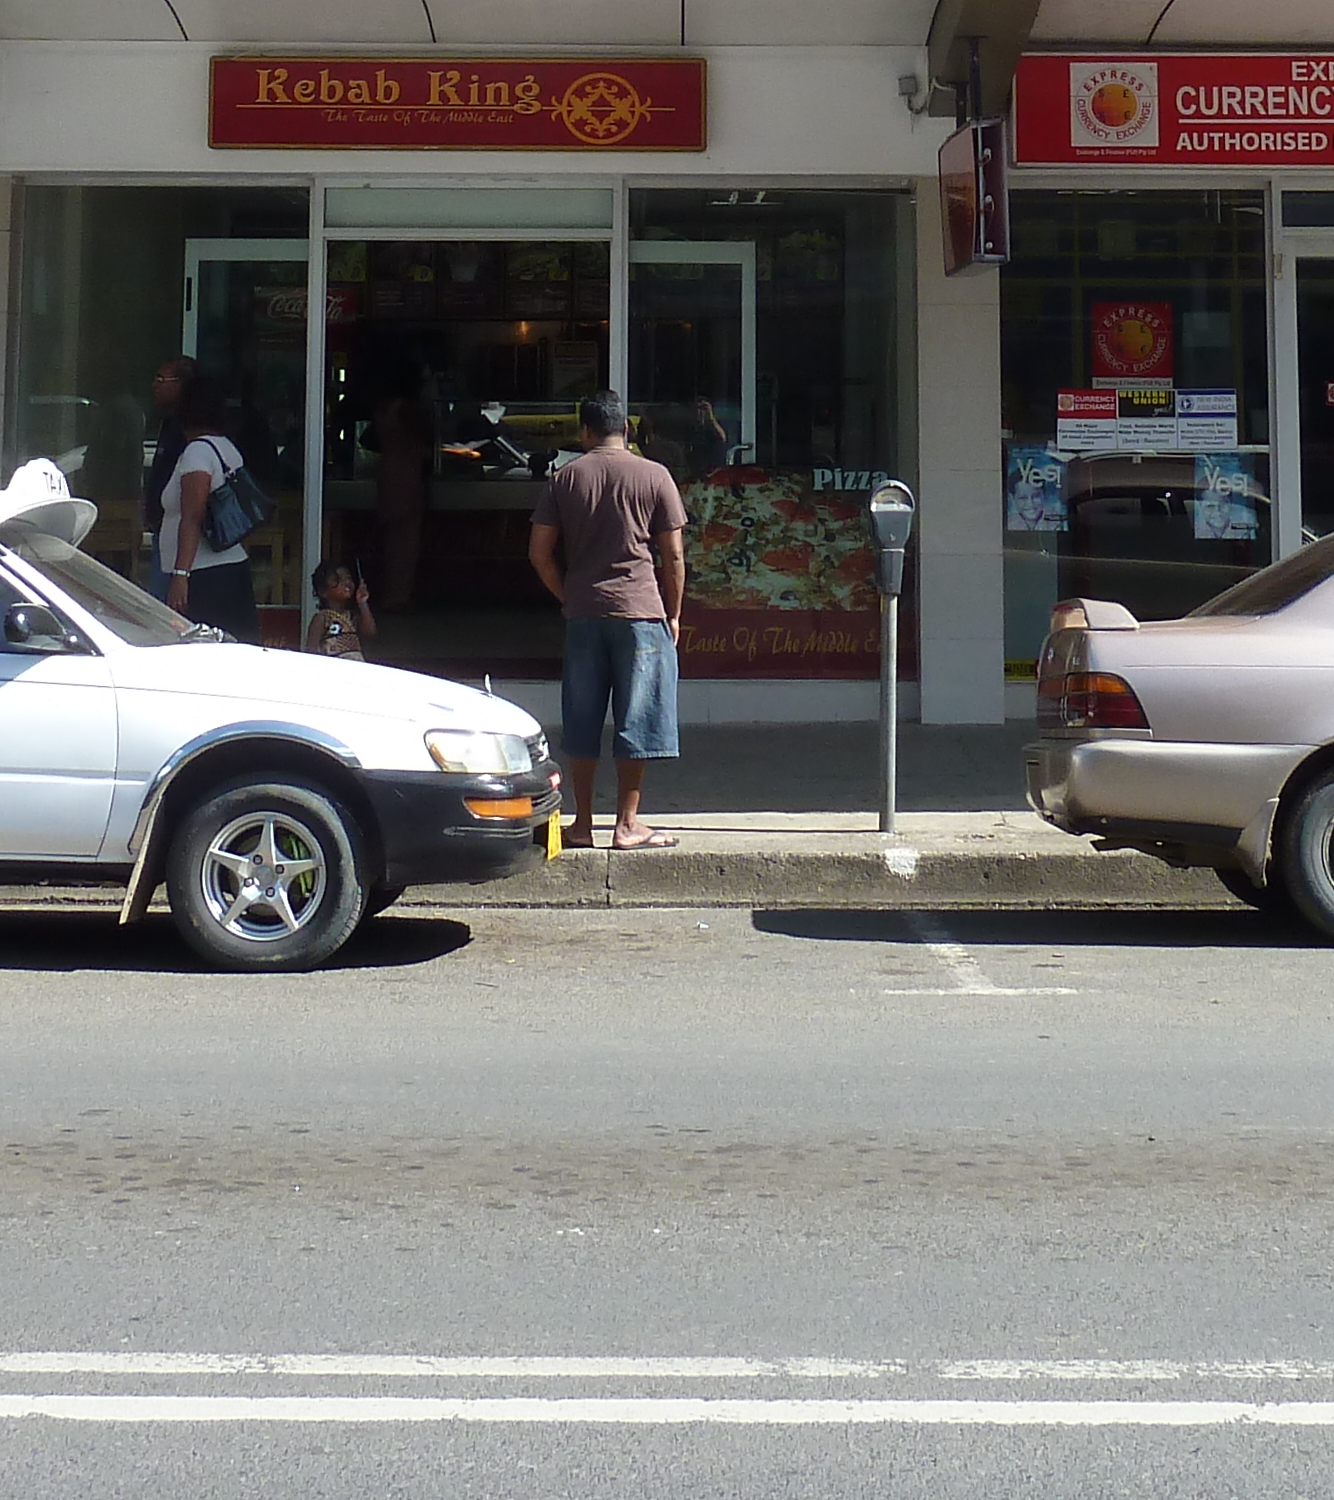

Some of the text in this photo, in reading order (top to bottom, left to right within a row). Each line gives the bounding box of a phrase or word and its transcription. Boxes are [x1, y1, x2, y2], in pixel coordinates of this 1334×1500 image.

[255, 68, 541, 114] Kebab King
[1083, 70, 1144, 92] EXPRESS
[321, 110, 514, 126] The Taste Of The Middle East
[1077, 98, 1151, 140] CURRENCY EXCHANGE
[1176, 132, 1328, 151] AUTHORISED
[1102, 307, 1160, 328] EXPRESS
[1098, 334, 1166, 373] CURRENCY EXCHANGE
[1118, 390, 1166, 399] WESTERN
[1133, 397, 1166, 406] UNION
[813, 468, 889, 491] Pizza
[1017, 458, 1062, 488] Yes!
[1204, 466, 1249, 497] Yes!
[733, 627, 758, 662] Of
[763, 627, 800, 653] The
[801, 630, 858, 657] Middle
